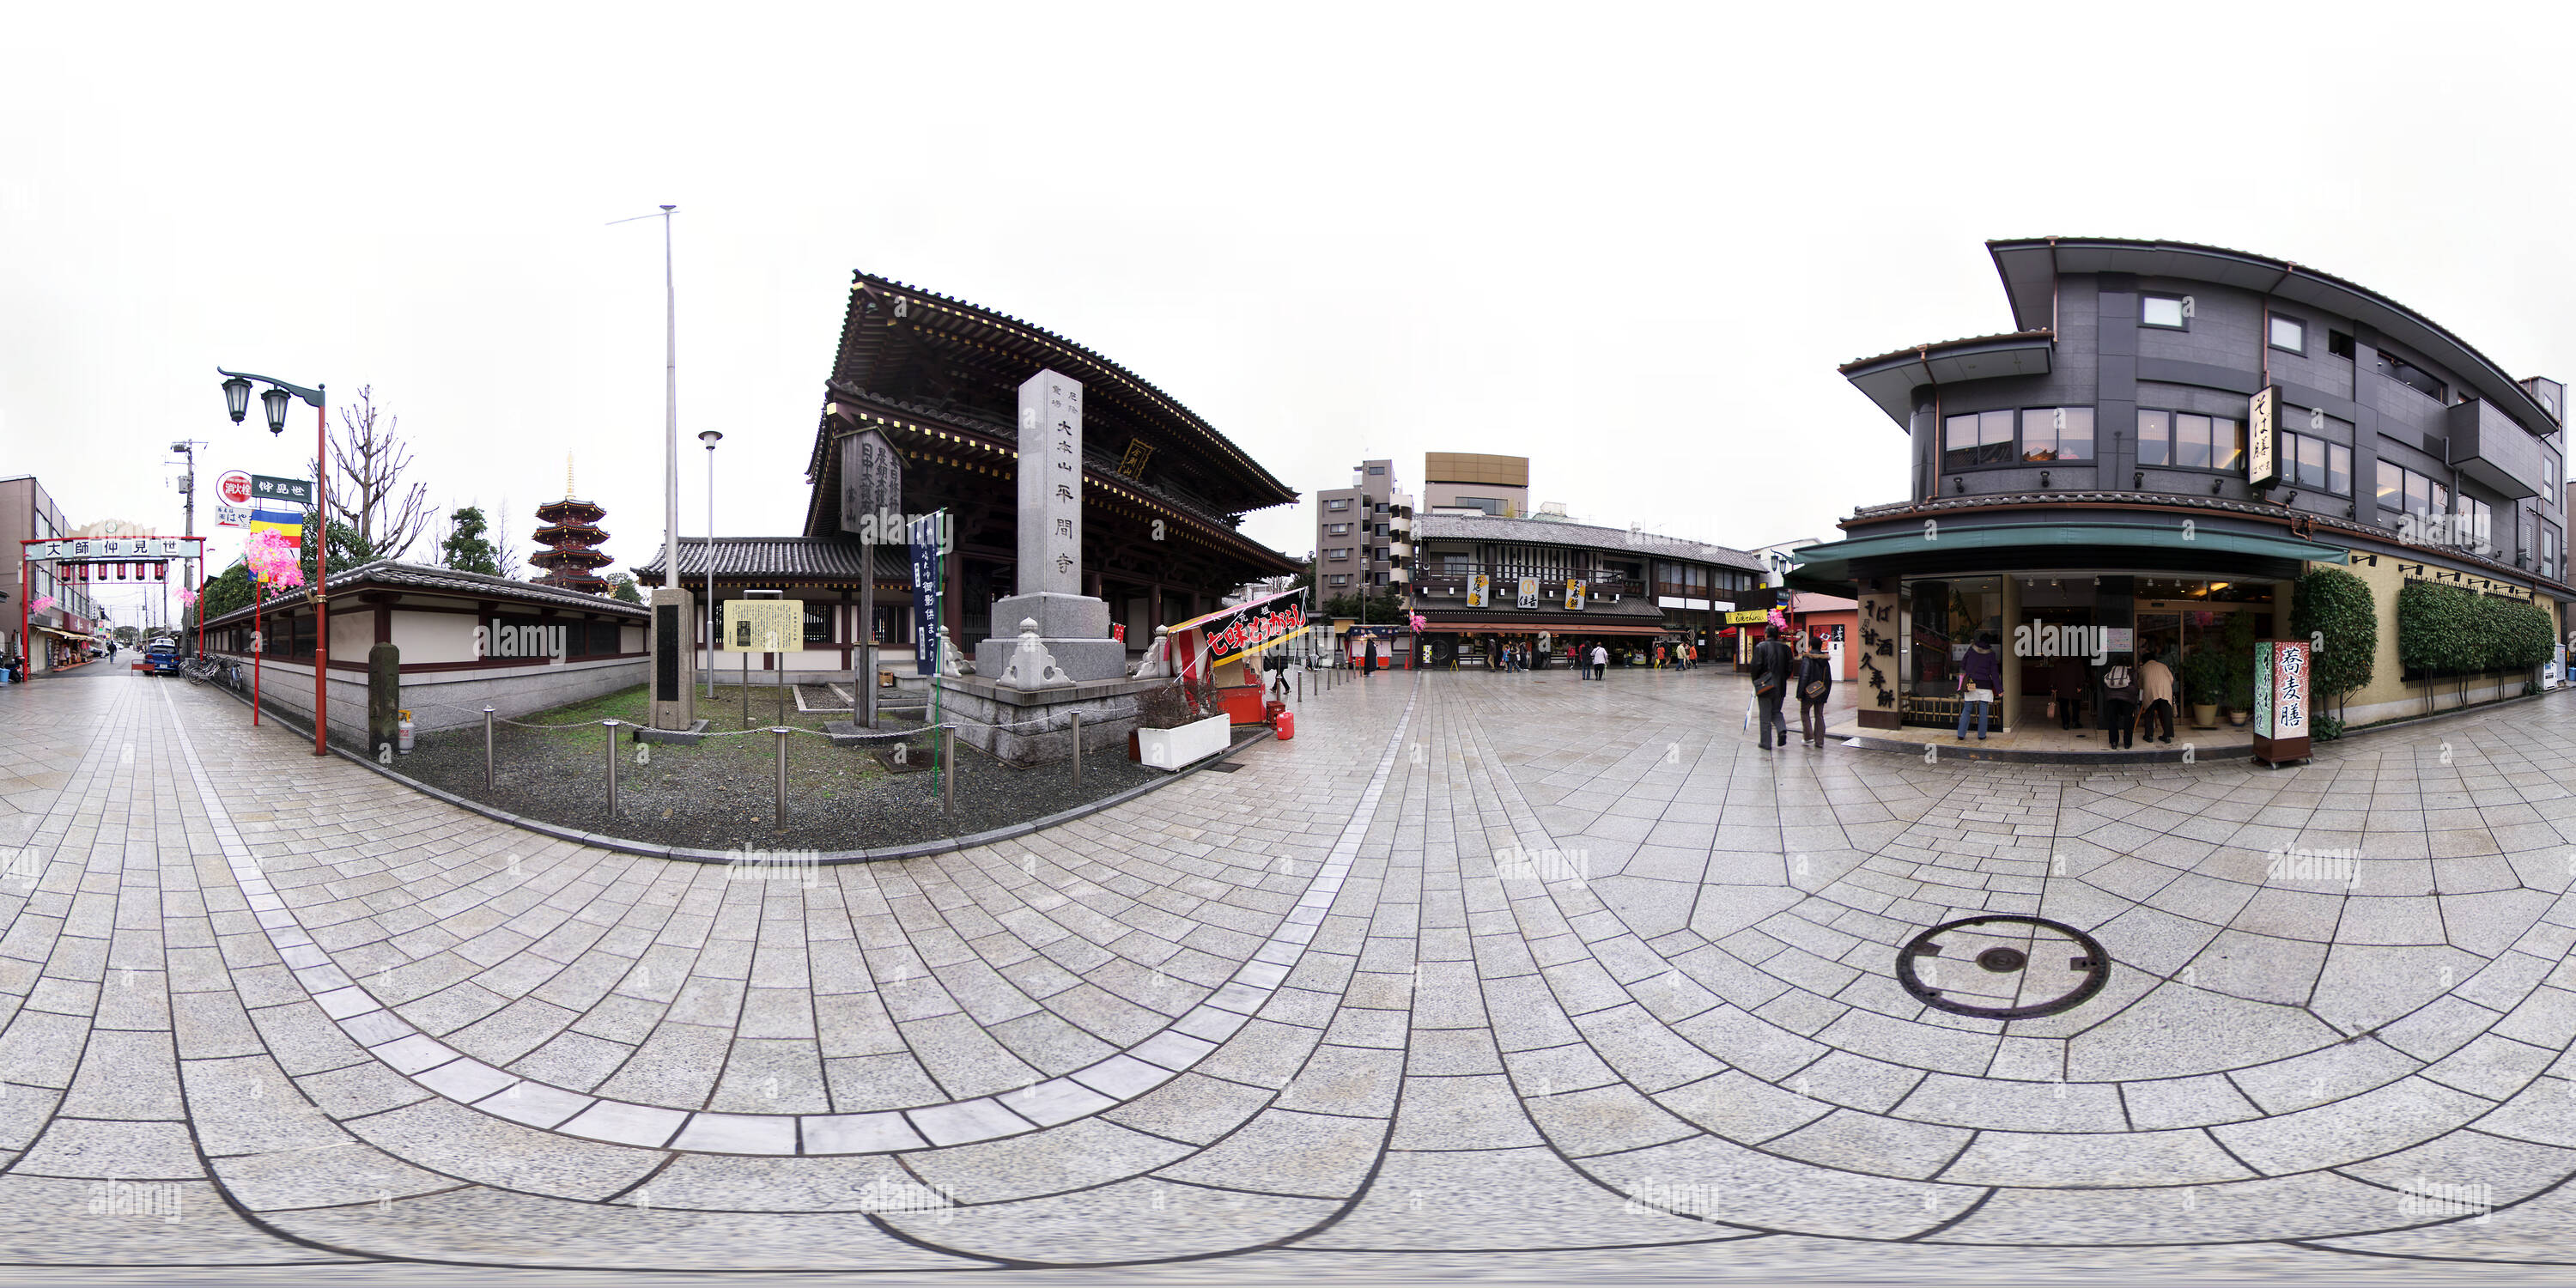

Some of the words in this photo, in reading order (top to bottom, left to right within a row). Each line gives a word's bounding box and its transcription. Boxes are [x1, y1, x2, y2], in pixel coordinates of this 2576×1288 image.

[225, 482, 252, 495] 消火栓
[258, 481, 305, 496] 仲見世
[47, 540, 177, 556] 大師仲見世
[1519, 595, 1537, 606] 住吉
[1206, 604, 1305, 656] 七味とうがらし
[1861, 629, 1893, 657] 甘酒
[2281, 647, 2304, 727] 蕎麦膳
